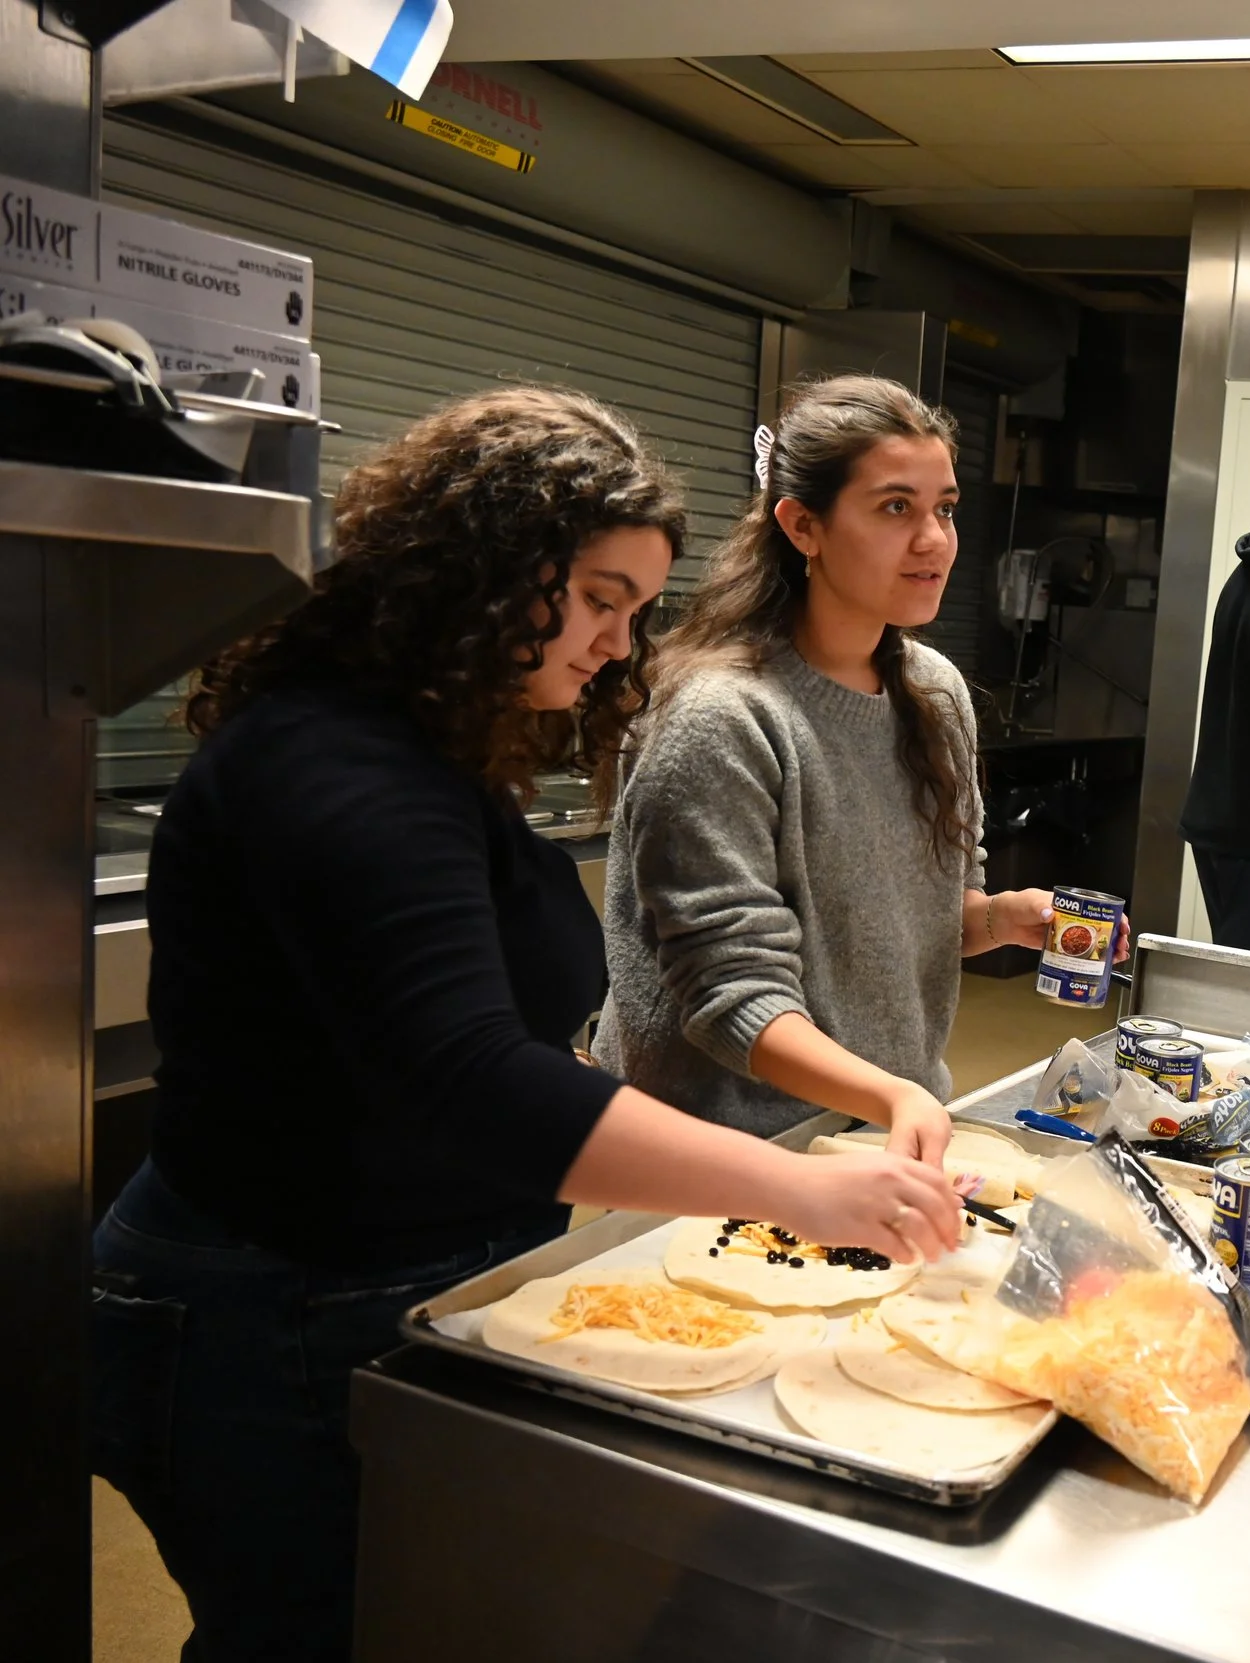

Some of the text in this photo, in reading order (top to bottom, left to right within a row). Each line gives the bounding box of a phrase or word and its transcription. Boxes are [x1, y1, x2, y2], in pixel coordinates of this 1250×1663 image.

[427, 125, 497, 158] CLOSING FIRE DOOR
[463, 131, 500, 151] AUTOMATIC
[1, 191, 79, 260] Silver
[117, 253, 179, 282] NITRILE
[181, 271, 242, 297] GLOVES
[1054, 896, 1080, 912] GOYA
[1069, 981, 1089, 991] GOYA
[1136, 1052, 1160, 1069] GOYA
[1153, 1121, 1161, 1133] 8
[1213, 1177, 1237, 1209] YA
